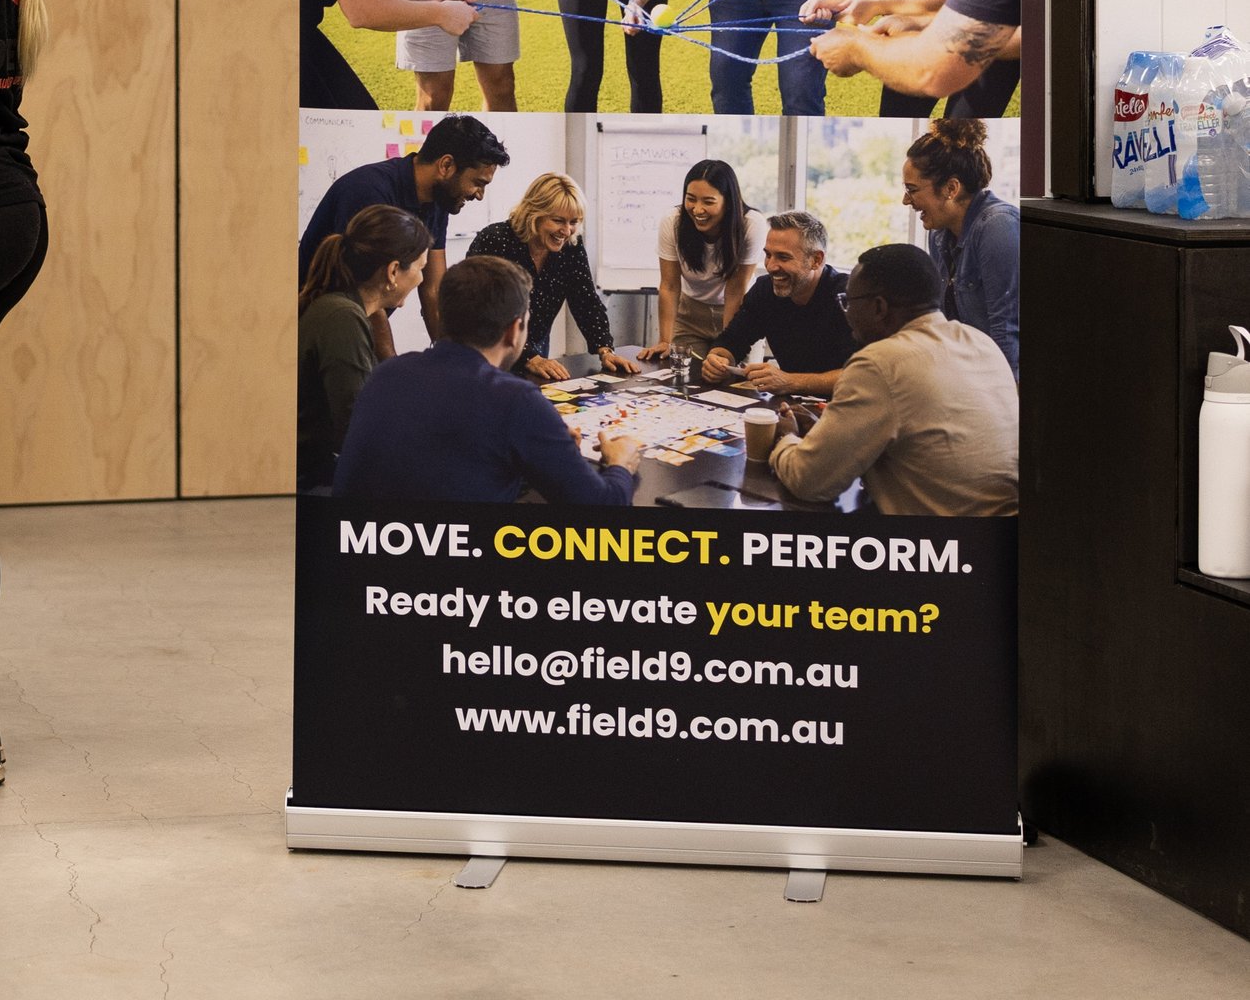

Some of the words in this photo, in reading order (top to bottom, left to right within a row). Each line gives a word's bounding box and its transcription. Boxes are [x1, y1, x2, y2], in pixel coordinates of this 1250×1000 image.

[611, 147, 689, 160] TEAMWORK
[340, 521, 482, 558] MOVE.
[493, 526, 730, 565] CONNECT.
[743, 532, 973, 573] PERFORM.
[366, 586, 489, 627] Ready
[498, 589, 538, 619] to
[547, 591, 698, 625] elevate
[706, 602, 799, 635] your
[809, 601, 940, 633] team?
[442, 644, 858, 689] hello@field9.com.au
[455, 704, 844, 745] www.field9.com.au
